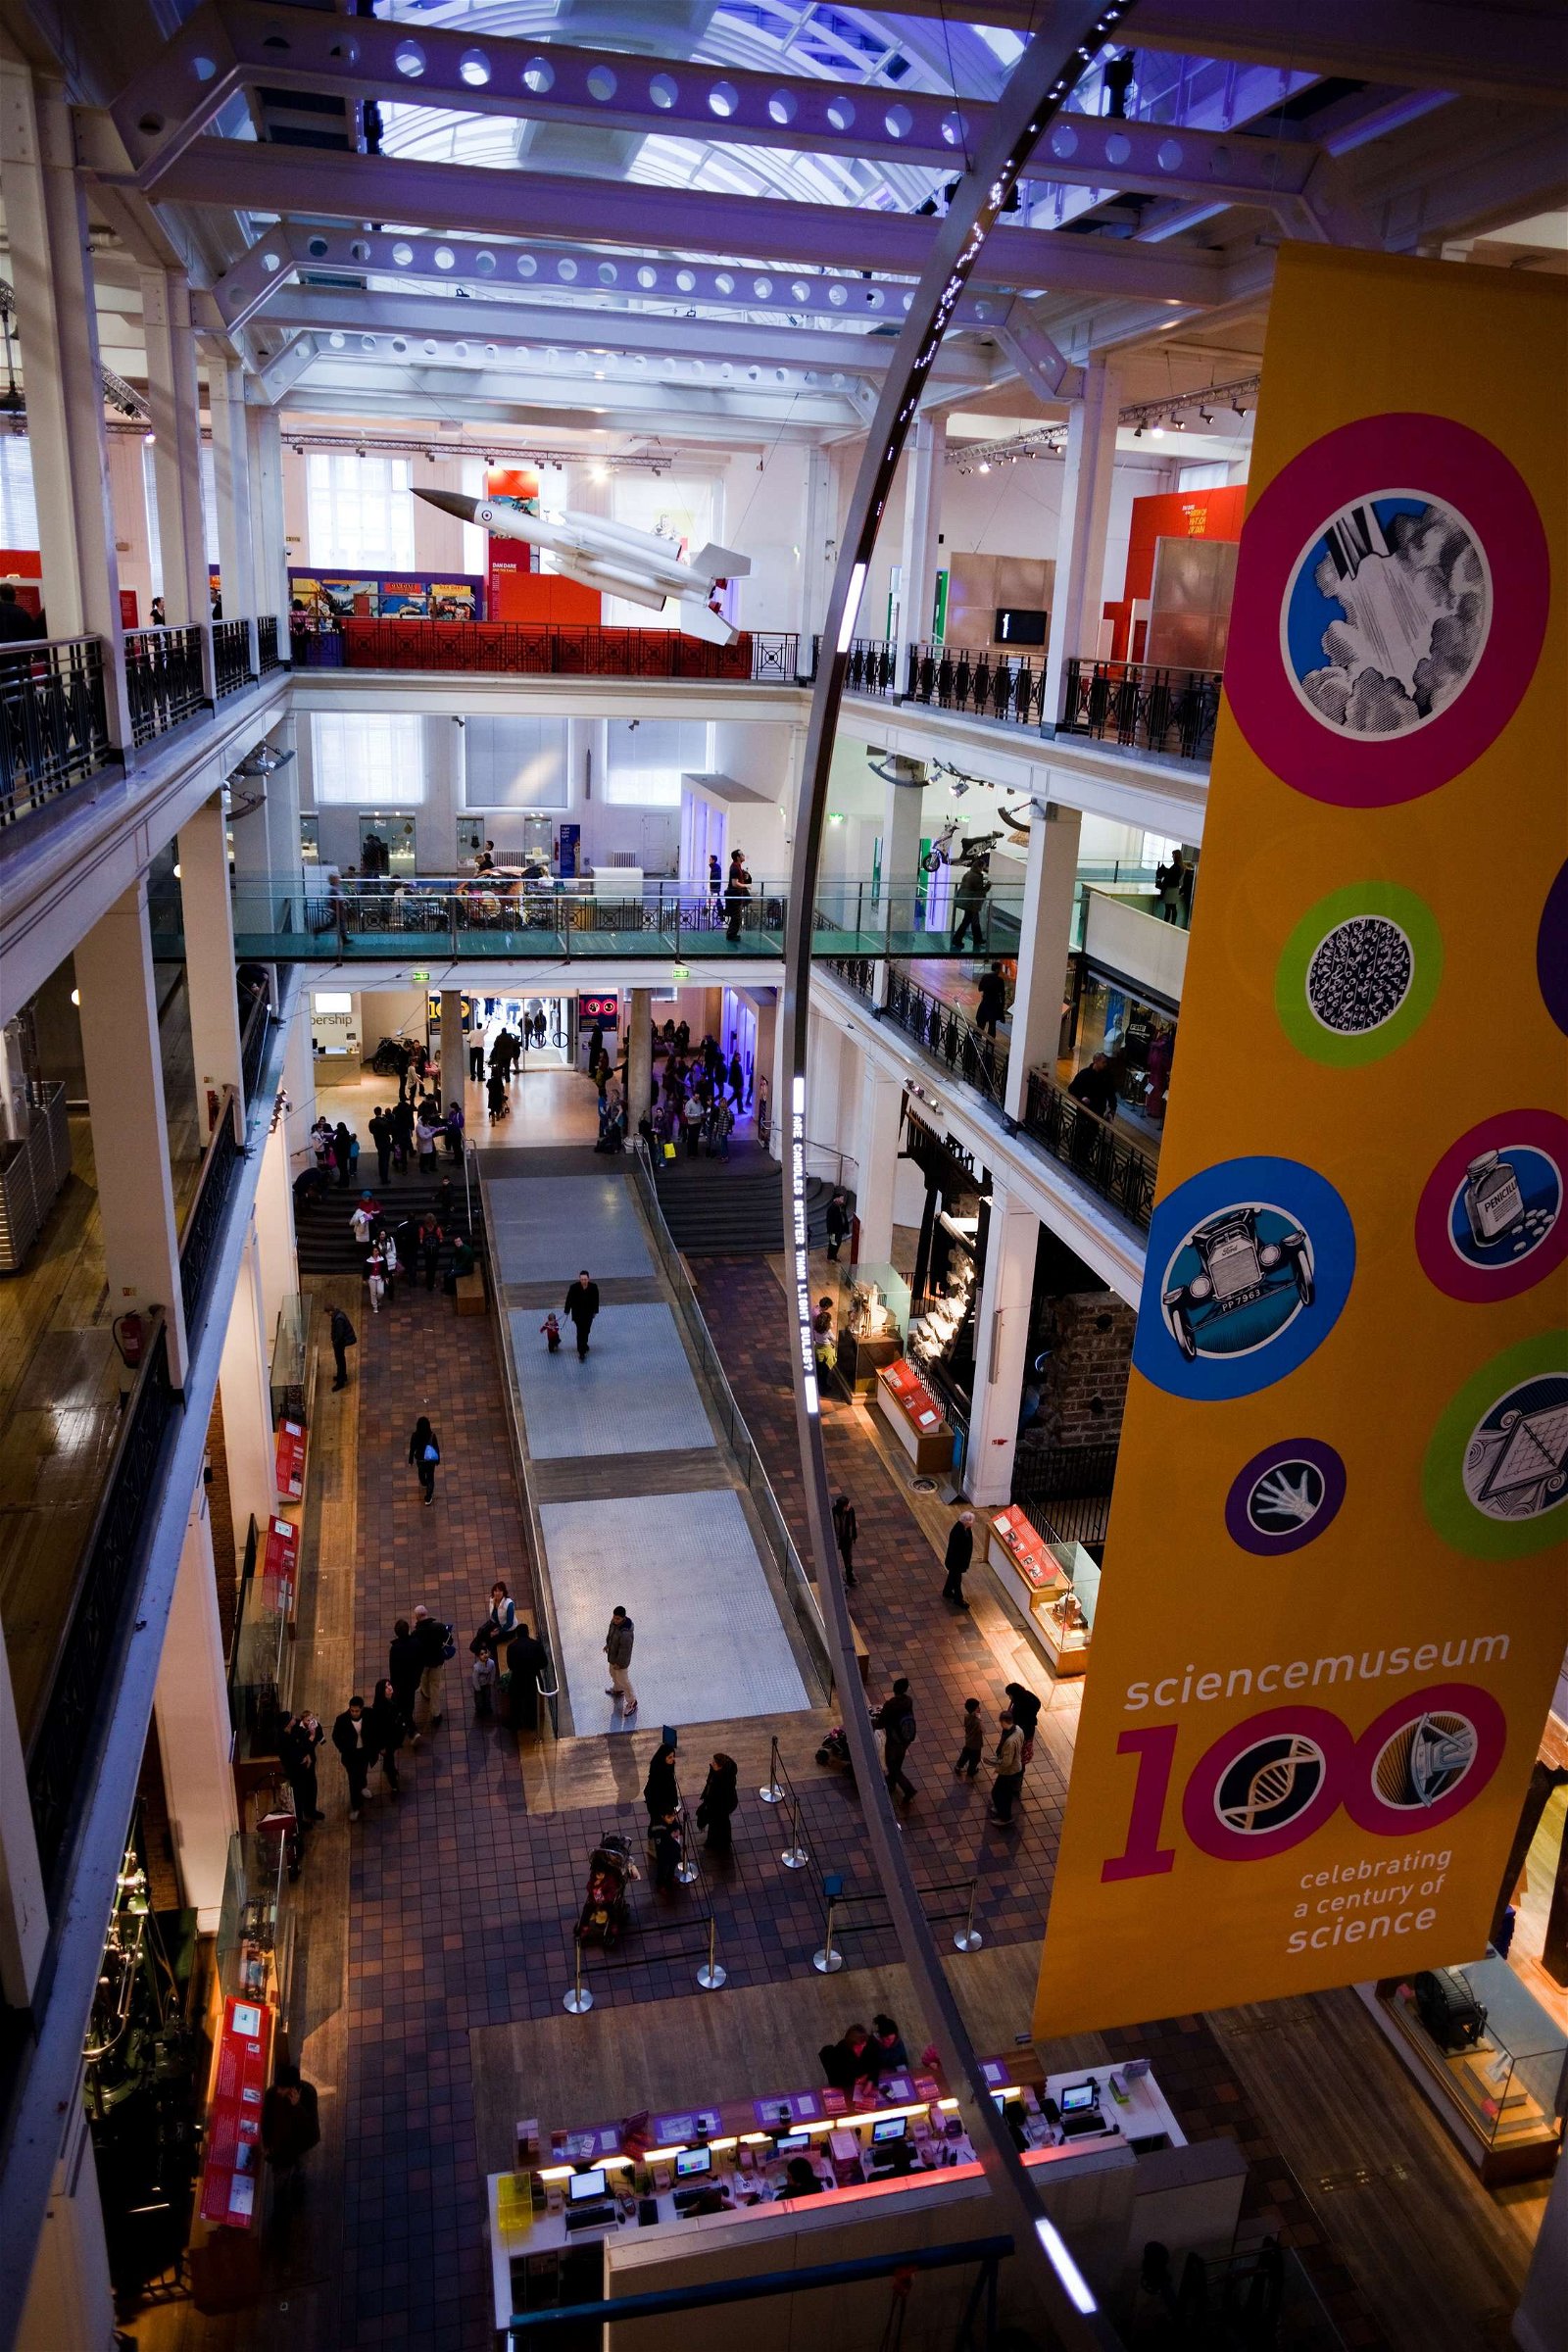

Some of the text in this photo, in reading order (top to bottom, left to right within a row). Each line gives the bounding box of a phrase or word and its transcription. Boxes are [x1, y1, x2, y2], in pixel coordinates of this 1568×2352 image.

[579, 999, 618, 1016] 100
[793, 1116, 813, 1371] ARE CANDLES BETTER THAN LIGHT BULBS?
[1222, 1245, 1238, 1255] Ford
[1222, 1290, 1261, 1311] PP 7963
[1124, 1634, 1510, 1711] sciencemuseum
[1101, 1683, 1506, 1884] 100
[1300, 1849, 1452, 1889] celebrating
[1294, 1874, 1446, 1918] a century of
[1286, 1907, 1437, 1953] science
